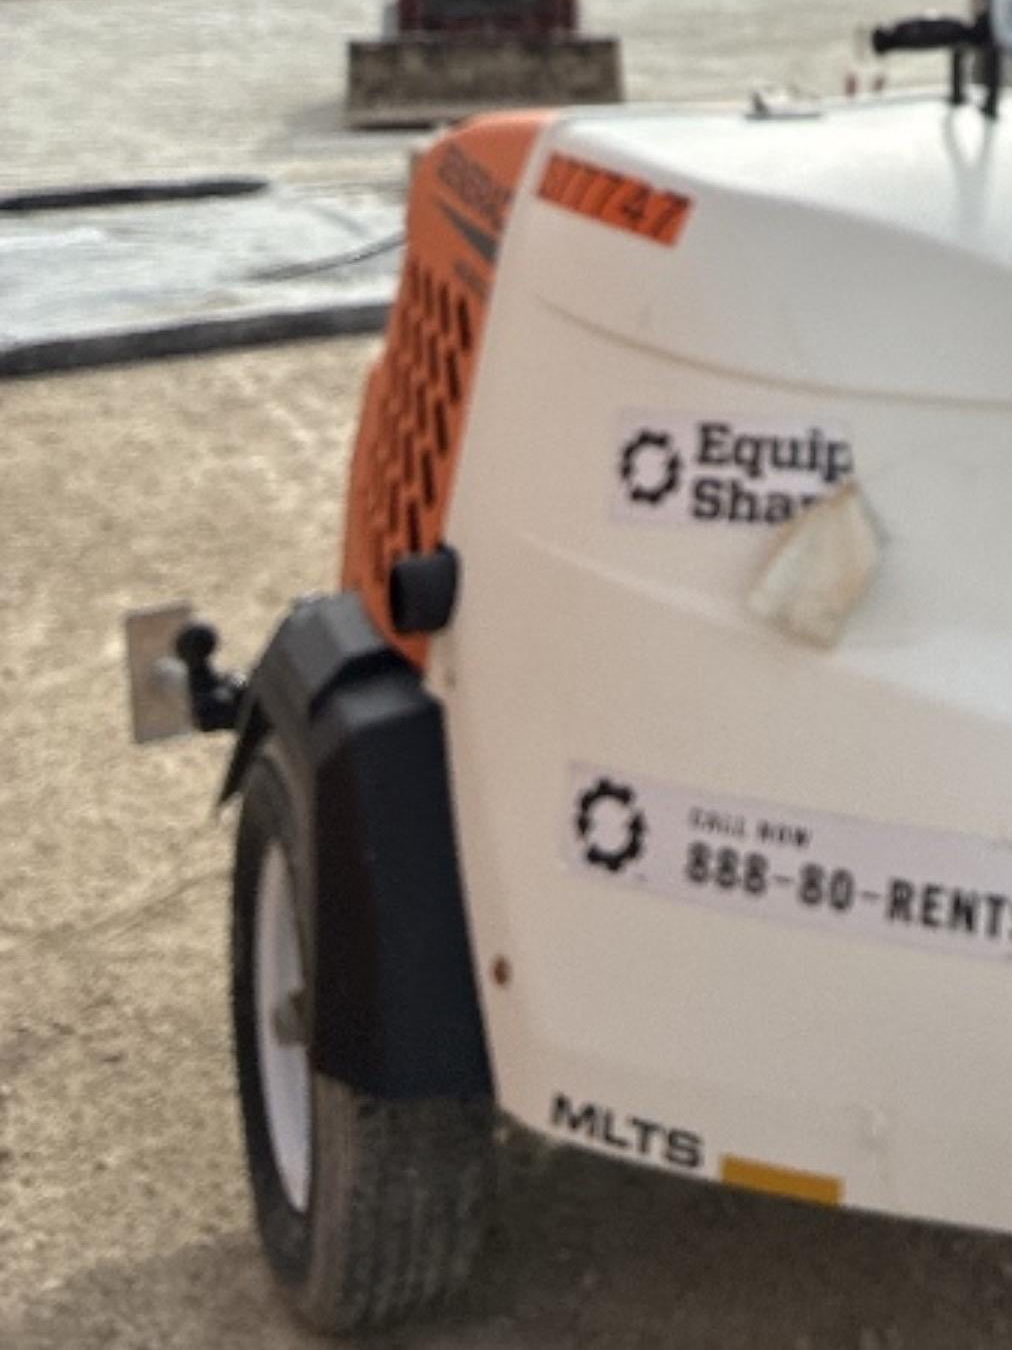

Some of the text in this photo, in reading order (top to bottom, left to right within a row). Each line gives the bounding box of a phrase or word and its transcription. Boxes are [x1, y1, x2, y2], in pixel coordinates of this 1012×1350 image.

[698, 421, 855, 484] Equip
[692, 477, 820, 525] Sha
[551, 1092, 704, 1169] MLTS
